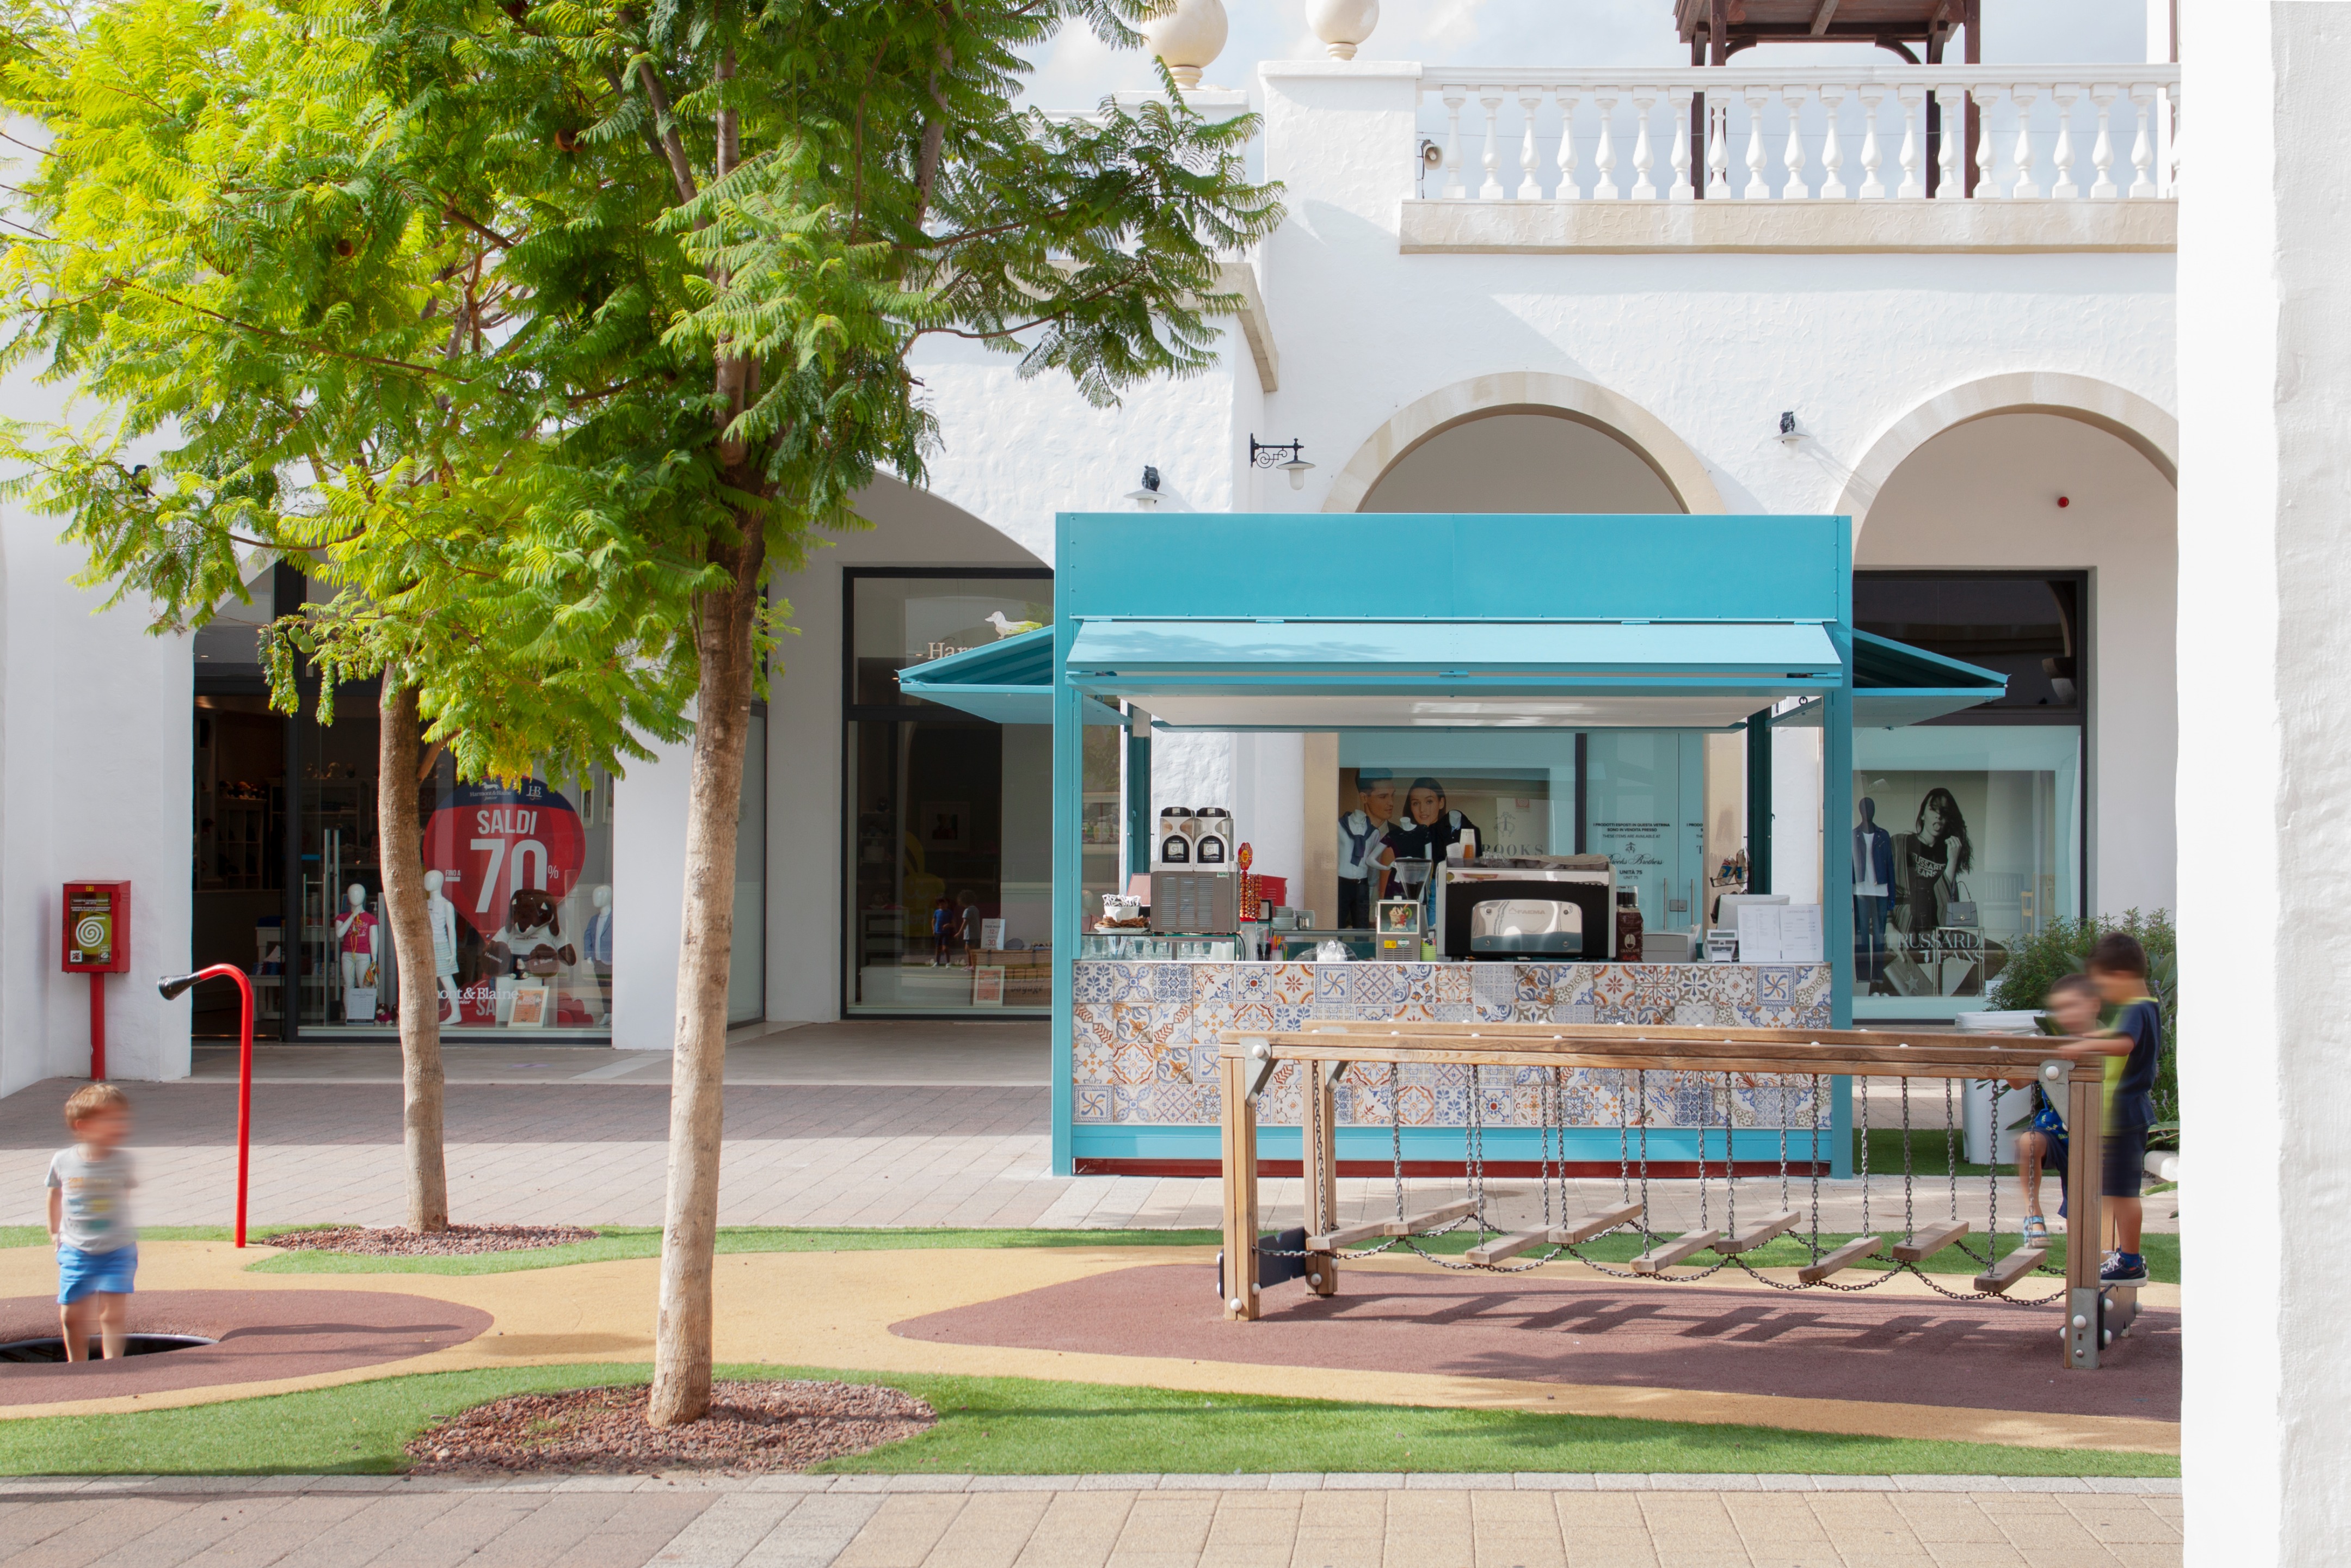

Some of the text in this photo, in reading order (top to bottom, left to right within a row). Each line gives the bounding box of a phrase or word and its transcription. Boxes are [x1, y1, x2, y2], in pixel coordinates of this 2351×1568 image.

[477, 809, 538, 835] SALDI
[1170, 844, 1182, 853] GT
[1205, 845, 1217, 853] GT
[1628, 853, 1665, 865] Brothers
